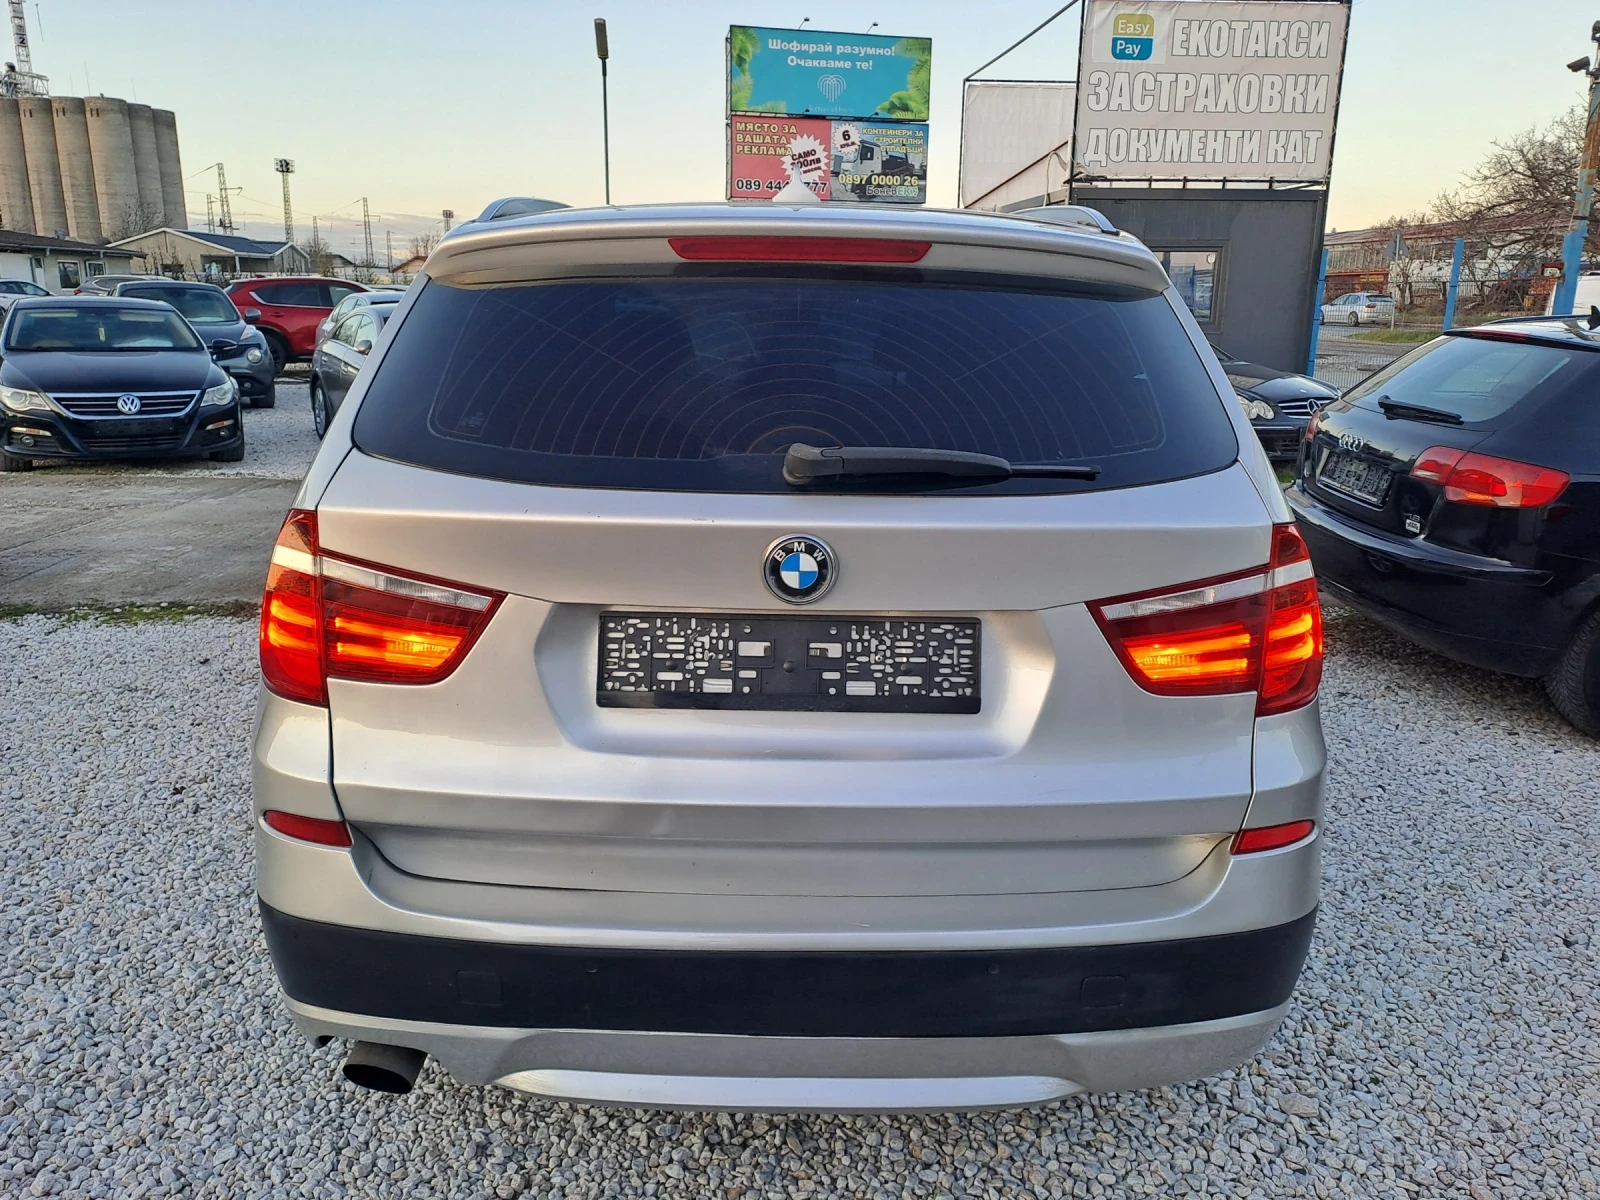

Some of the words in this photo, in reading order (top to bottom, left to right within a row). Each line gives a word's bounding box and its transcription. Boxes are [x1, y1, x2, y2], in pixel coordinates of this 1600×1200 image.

[1117, 19, 1150, 36] Easy
[1171, 18, 1332, 58] ЕКОТАКСИ
[768, 38, 833, 53] Шофирай
[836, 44, 895, 57] разумно!
[1115, 40, 1142, 57] Pay
[787, 55, 852, 69] Очакваме
[855, 60, 873, 70] те!
[1086, 70, 1330, 114] ЗАСТРАХОВКИ
[736, 122, 778, 134] МЯСТО
[782, 124, 797, 134] ЗА
[862, 127, 913, 137] КОНТЕЙНЕРИ
[914, 129, 924, 137] ЗА
[736, 133, 787, 145] ВАШАТА
[842, 129, 851, 141] 6
[873, 136, 924, 145] СТРОИТЕЛНИ
[736, 144, 794, 156] РЕКЛАМА
[1083, 127, 1262, 168] ДОКУМЕНТИ
[1266, 130, 1323, 164] КАТ
[791, 149, 817, 161] САМО
[736, 179, 761, 191] 089
[838, 173, 868, 185] 0897
[871, 174, 901, 186] 0000
[903, 176, 919, 186] 26
[774, 541, 826, 562] BMW
